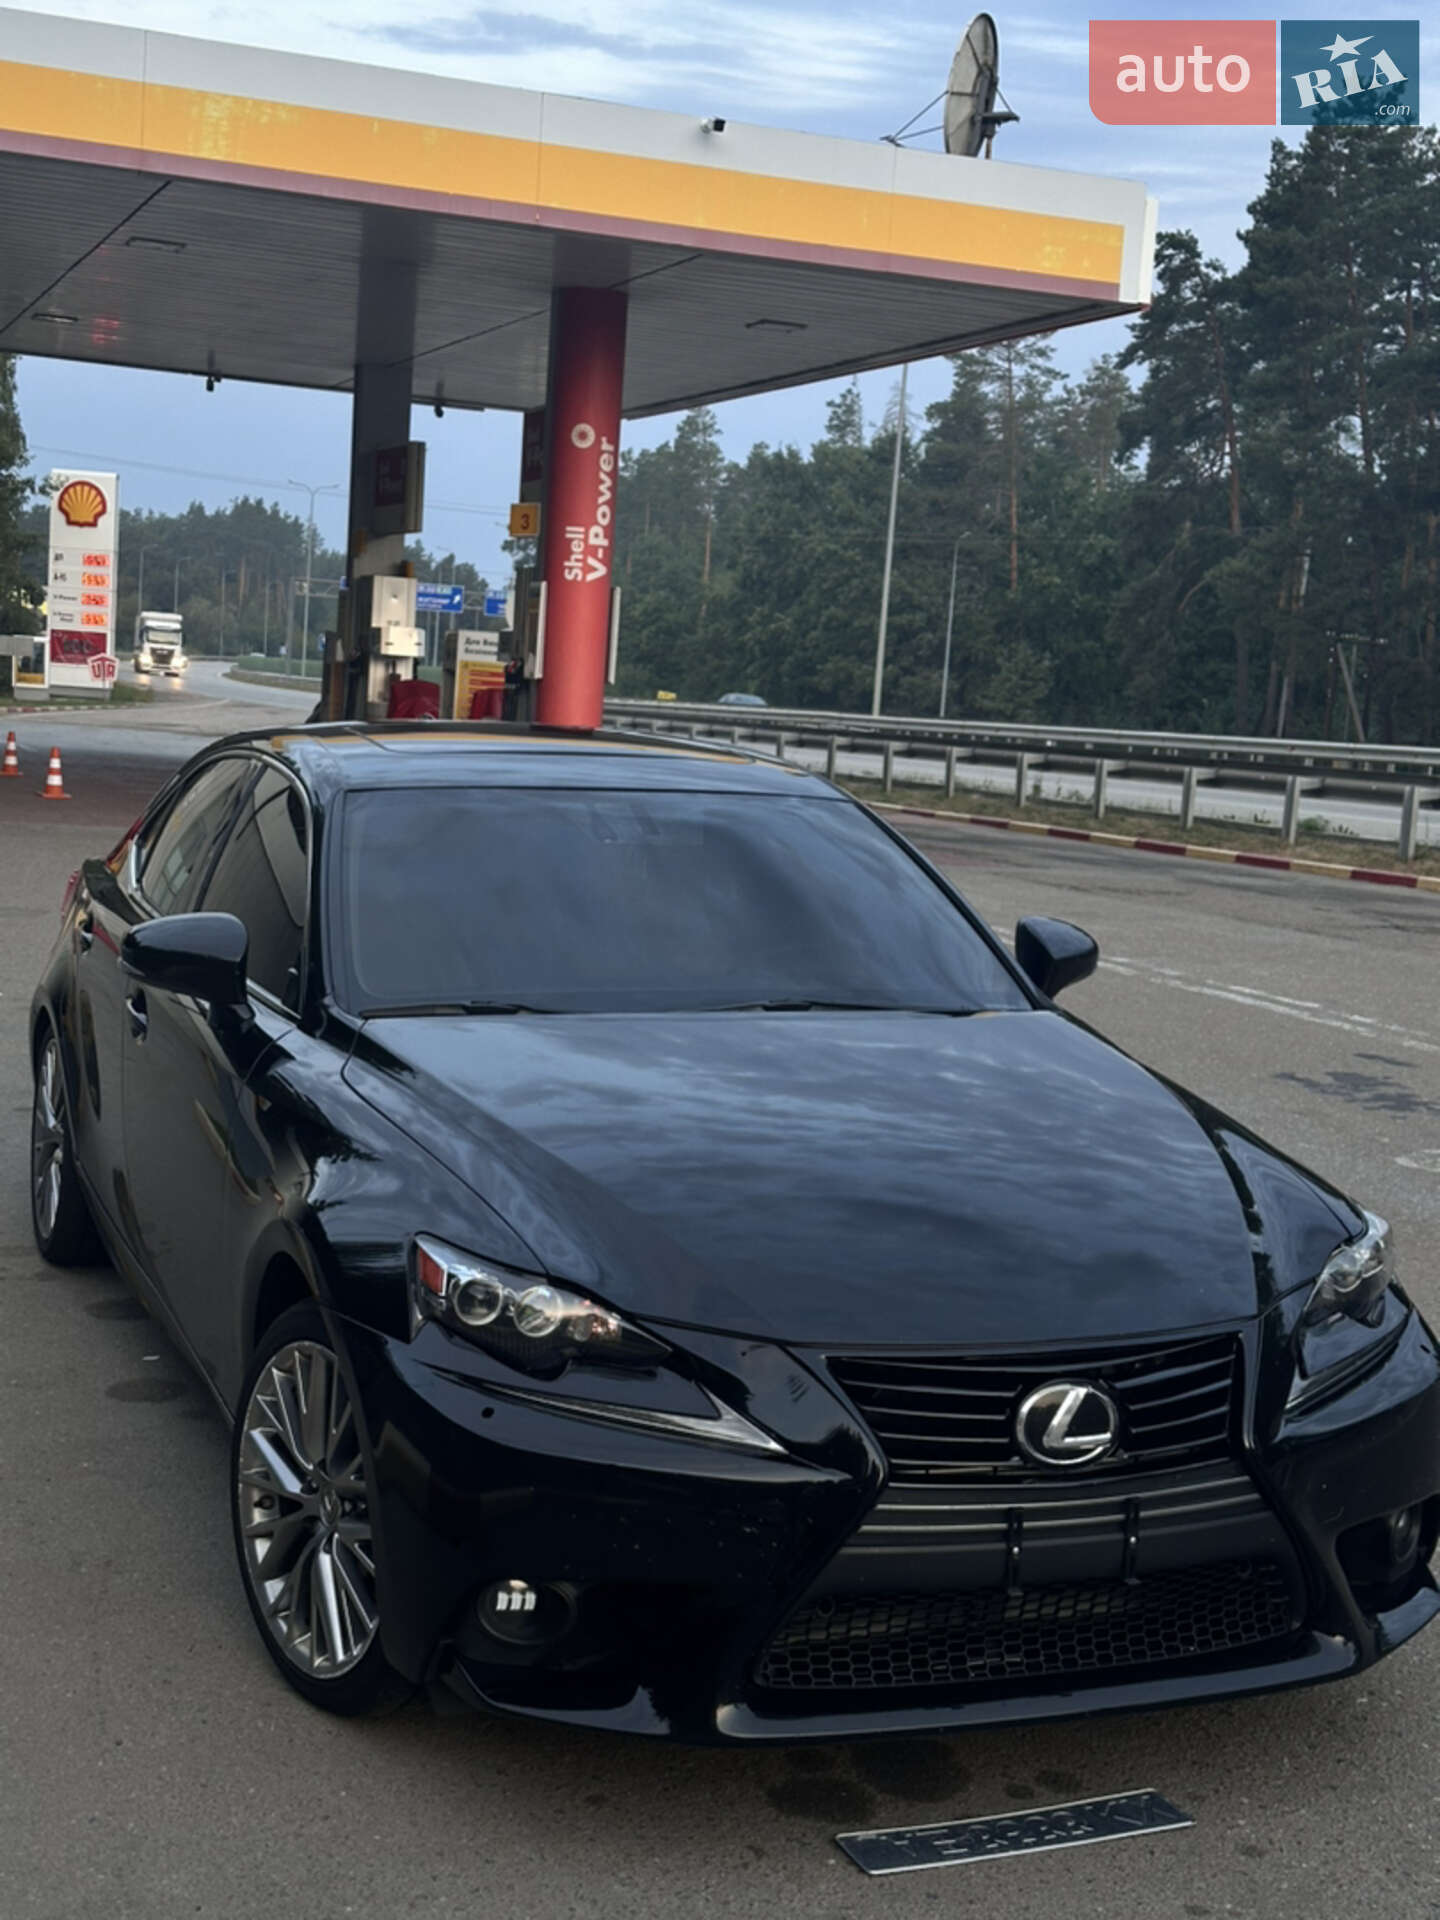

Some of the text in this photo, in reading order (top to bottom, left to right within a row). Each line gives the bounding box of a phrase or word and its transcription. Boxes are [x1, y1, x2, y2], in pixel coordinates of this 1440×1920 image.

[520, 513, 531, 531] 3
[586, 436, 615, 583] V-Power
[563, 526, 586, 582] Shell
